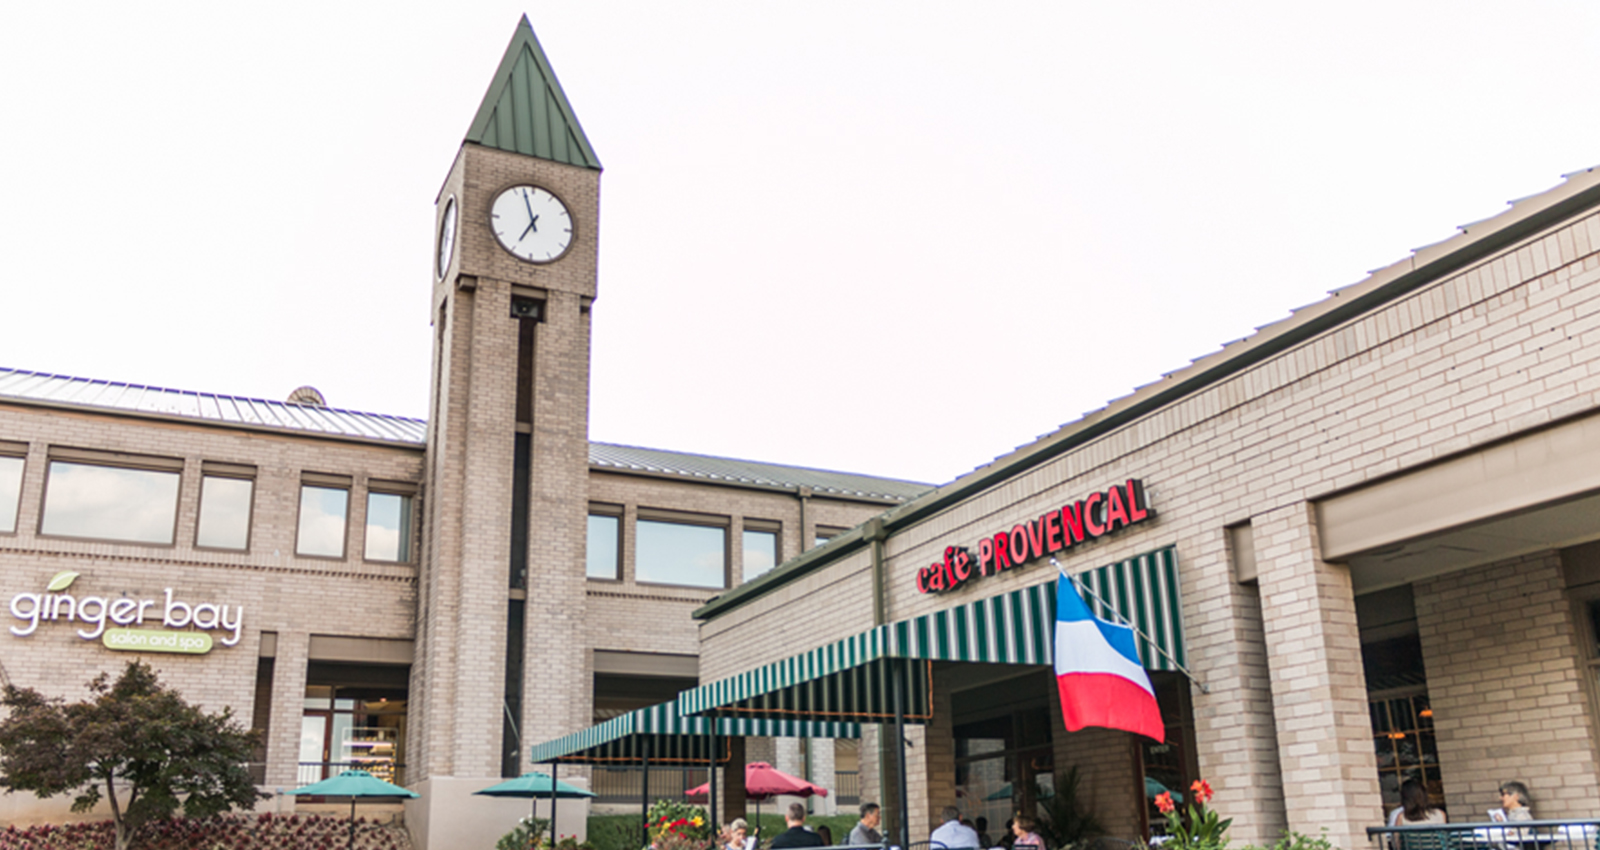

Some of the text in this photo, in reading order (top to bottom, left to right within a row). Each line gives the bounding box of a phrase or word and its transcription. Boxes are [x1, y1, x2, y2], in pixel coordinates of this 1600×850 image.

[916, 478, 1147, 594] café PROVENCAL
[9, 587, 244, 646] ginger bay
[111, 630, 204, 651] salon and spa
